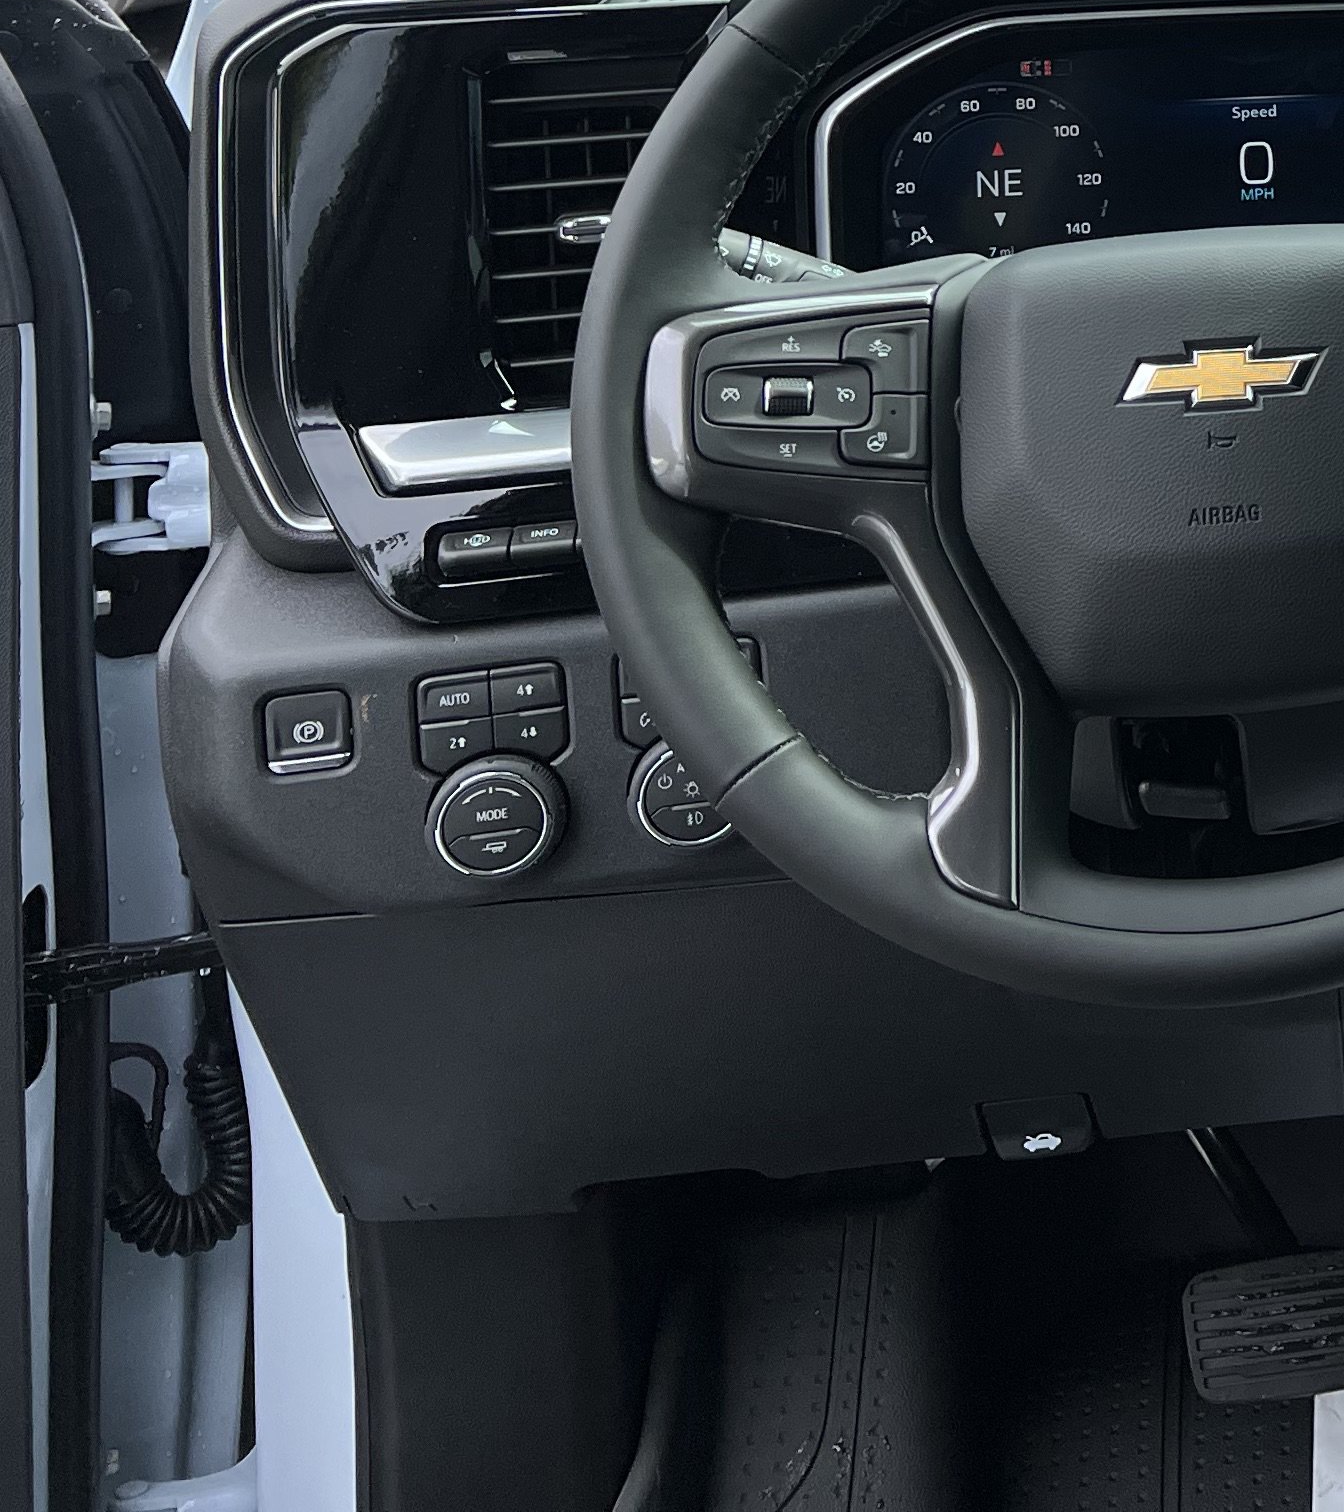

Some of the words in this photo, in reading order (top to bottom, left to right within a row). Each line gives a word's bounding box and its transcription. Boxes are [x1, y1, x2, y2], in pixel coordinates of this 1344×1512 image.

[960, 100, 980, 113] 60
[1015, 98, 1036, 110] 80
[1231, 104, 1278, 122] Speed
[913, 131, 933, 144] 40
[1053, 125, 1080, 138] 100
[1239, 141, 1274, 185] 0
[976, 169, 1024, 198] NE
[1077, 173, 1102, 186] 120
[895, 182, 916, 195] 20
[1240, 187, 1275, 201] MPH
[1065, 222, 1091, 235] 140
[781, 342, 800, 353] RES
[779, 443, 797, 454] SET
[1187, 503, 1261, 527] AIRBAG
[530, 528, 559, 538] INFO
[516, 685, 525, 697] 4
[439, 692, 471, 707] AUTO
[520, 727, 528, 739] 4
[449, 737, 458, 750] 2
[475, 807, 509, 823] MODE
